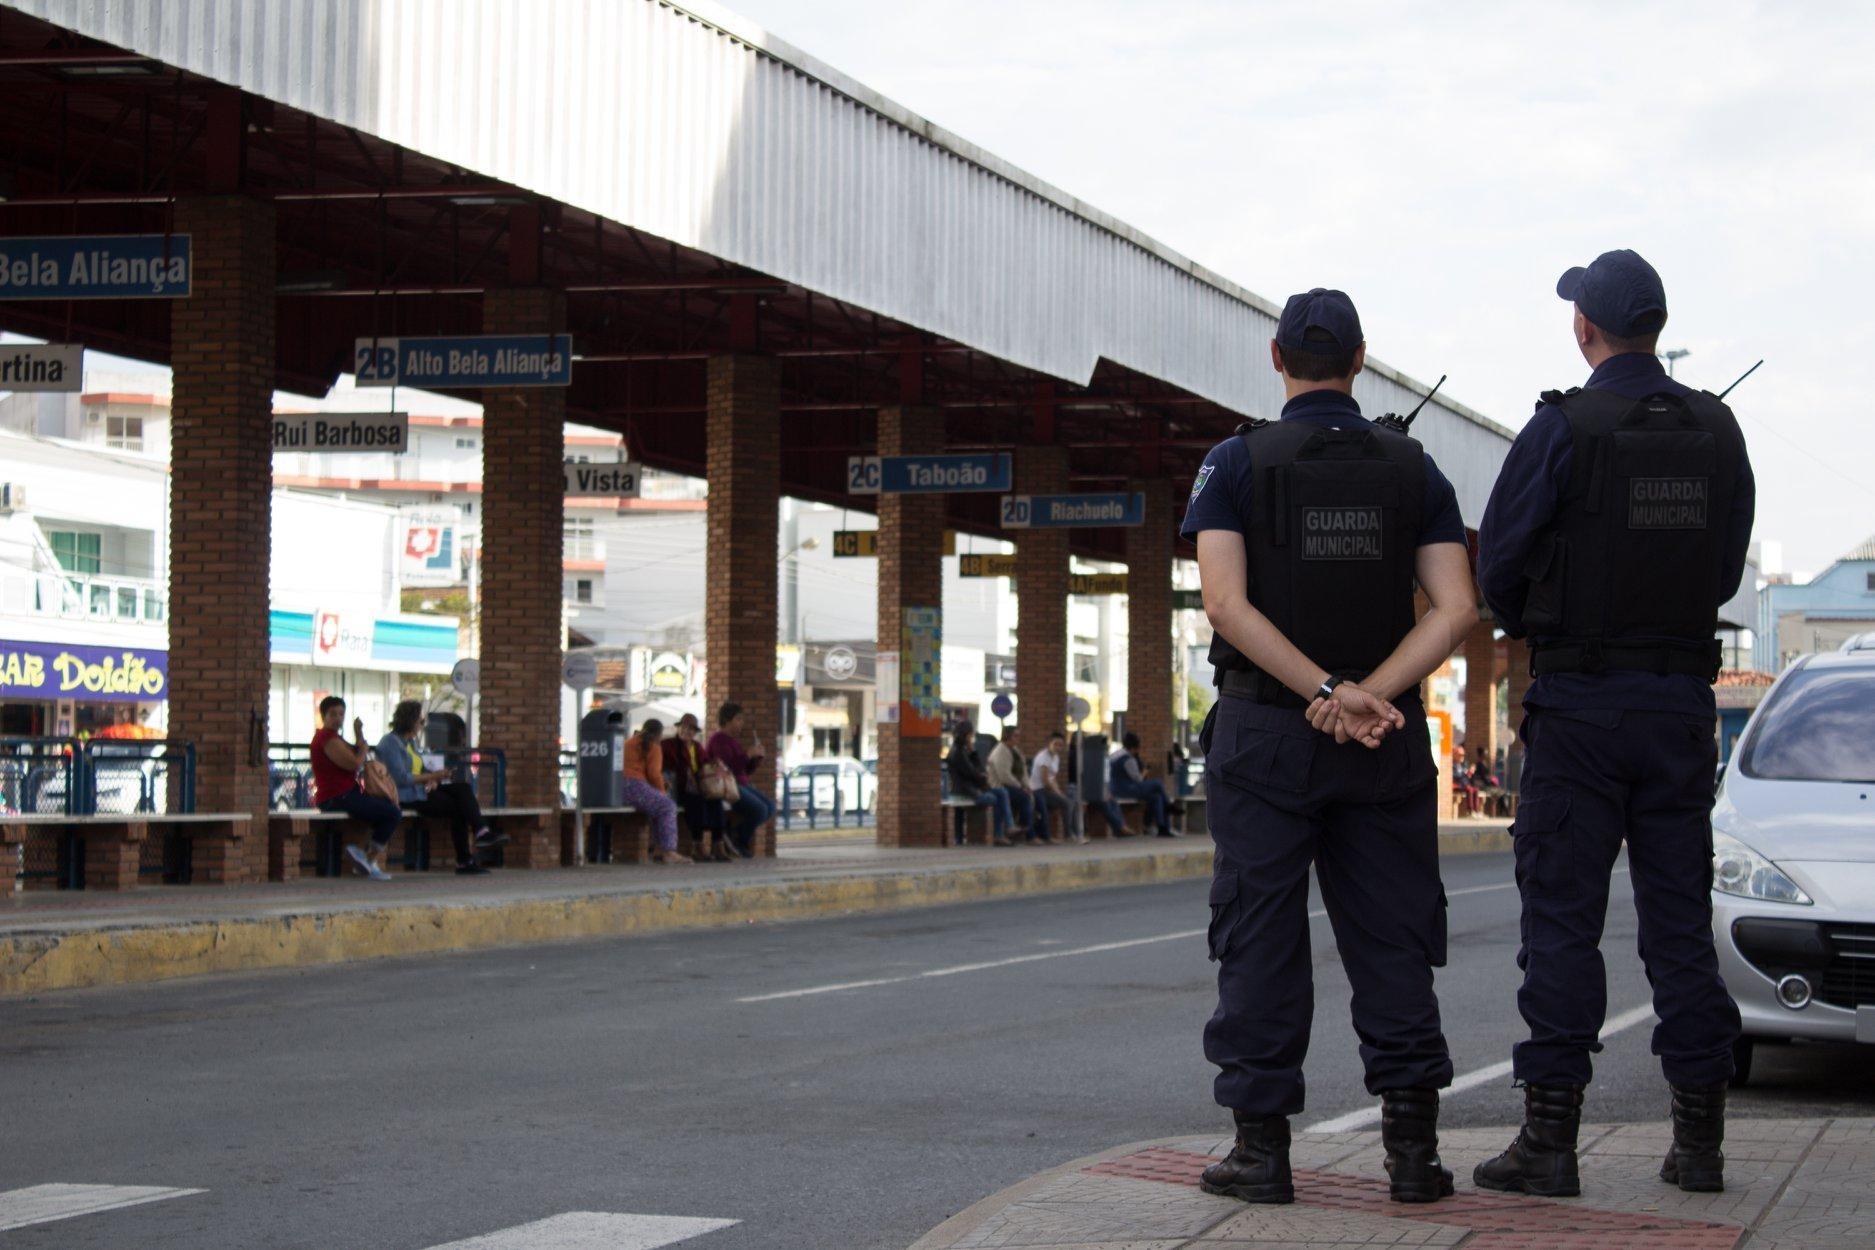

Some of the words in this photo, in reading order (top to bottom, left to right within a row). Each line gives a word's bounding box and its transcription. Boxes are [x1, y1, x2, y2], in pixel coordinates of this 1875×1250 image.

[68, 251, 187, 293] Aliança
[0, 353, 63, 383] rtina
[357, 347, 397, 381] 2B
[406, 351, 443, 376] Alto
[449, 349, 488, 375] Bela
[493, 347, 562, 380] Aliança
[274, 421, 307, 447] Rui
[315, 418, 400, 446] Barbosa
[577, 469, 634, 492] Vista
[851, 463, 880, 489] 2C
[906, 461, 988, 486] Taboão
[1634, 481, 1705, 501] GUARDA
[1004, 502, 1030, 523] 2D
[1052, 500, 1124, 521] Riachuelo
[1306, 511, 1380, 531] GUARDA
[1632, 506, 1704, 526] MUNICIPAL
[1305, 536, 1380, 556] MUNICIPAL
[53, 651, 164, 694] Doidão
[581, 741, 609, 757] 226
